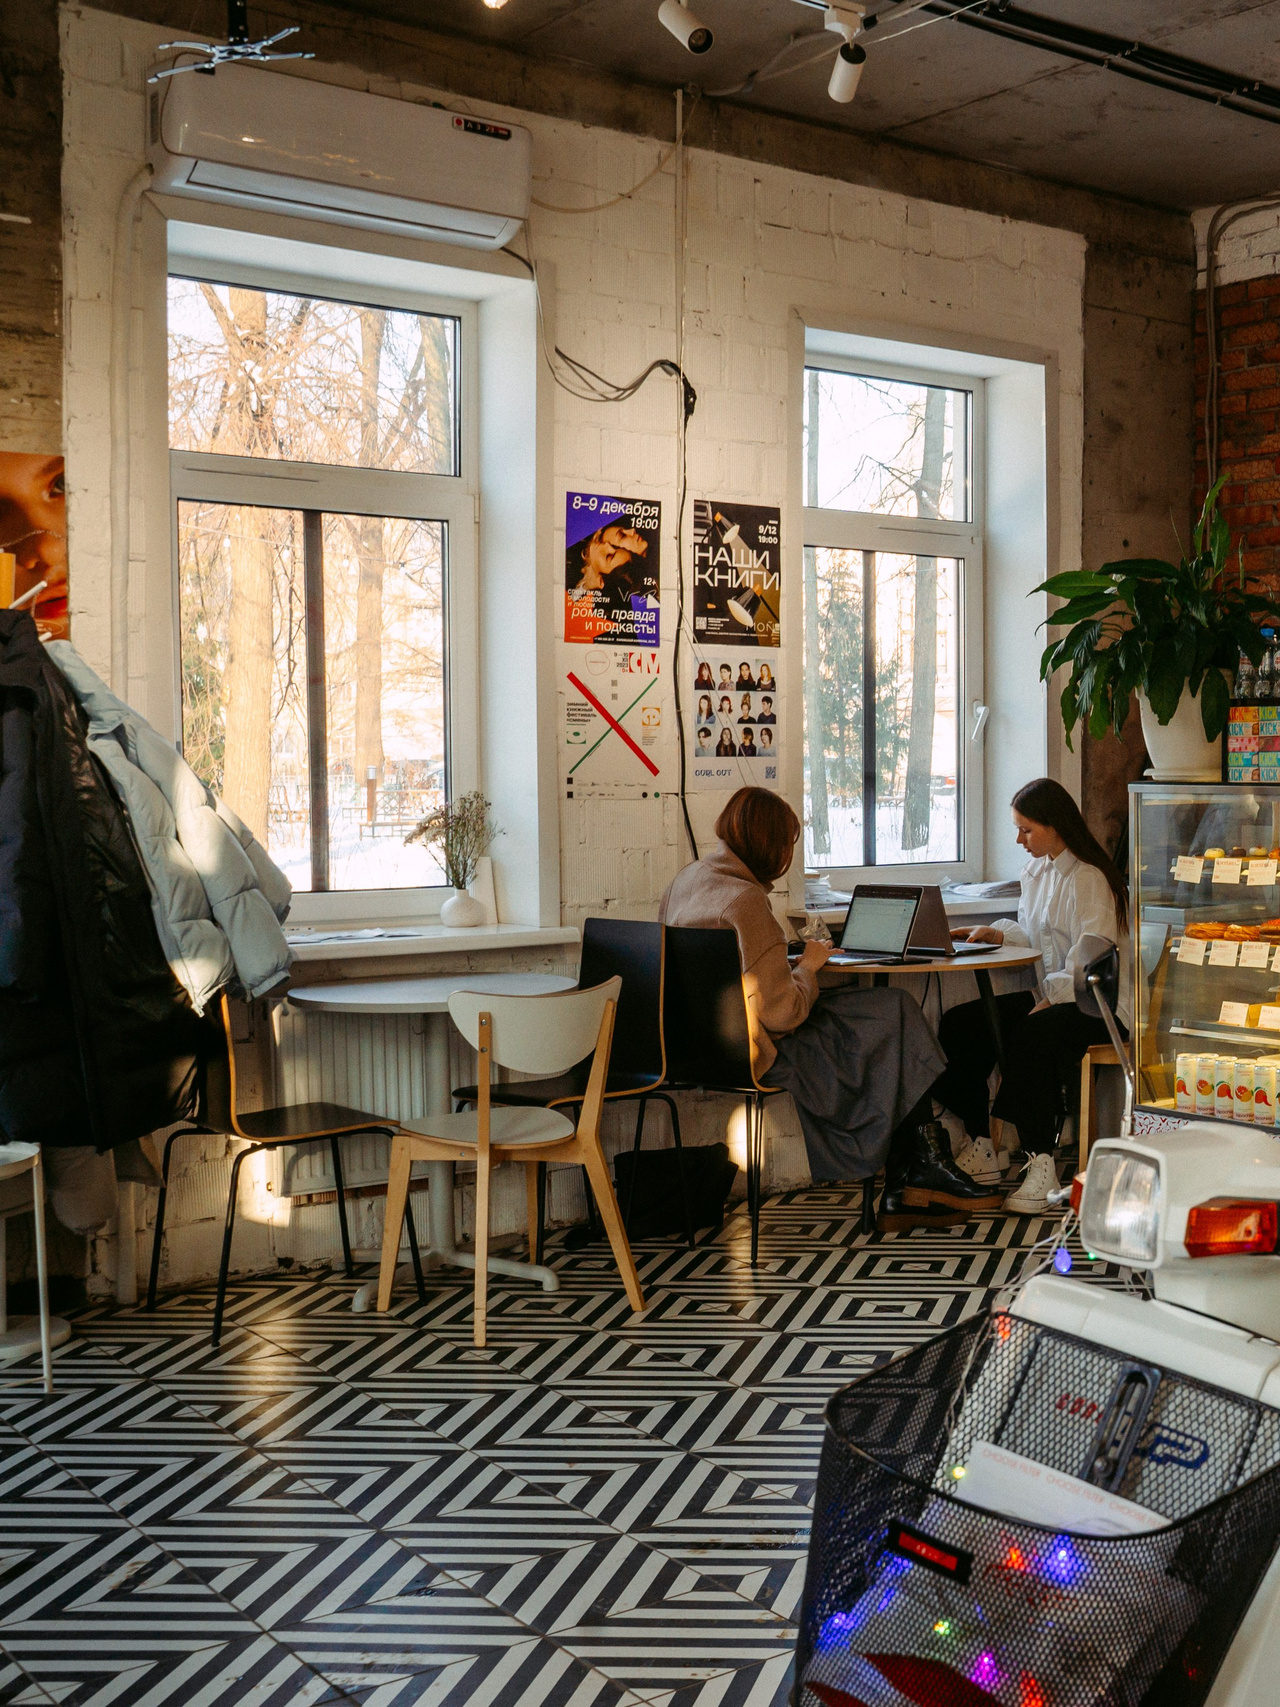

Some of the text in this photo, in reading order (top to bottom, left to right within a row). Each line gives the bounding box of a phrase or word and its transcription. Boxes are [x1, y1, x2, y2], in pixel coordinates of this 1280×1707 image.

[600, 501, 659, 519] декабря
[630, 517, 658, 530] 19:00
[758, 525, 777, 535] 9/12
[758, 535, 778, 544] 19:00
[694, 545, 770, 569] НАШИ
[643, 577, 656, 586] 12+
[694, 566, 779, 591] КНИГИ
[571, 608, 656, 623] рома, правда
[585, 621, 656, 635] и подкасты
[1260, 722, 1278, 735] KICK
